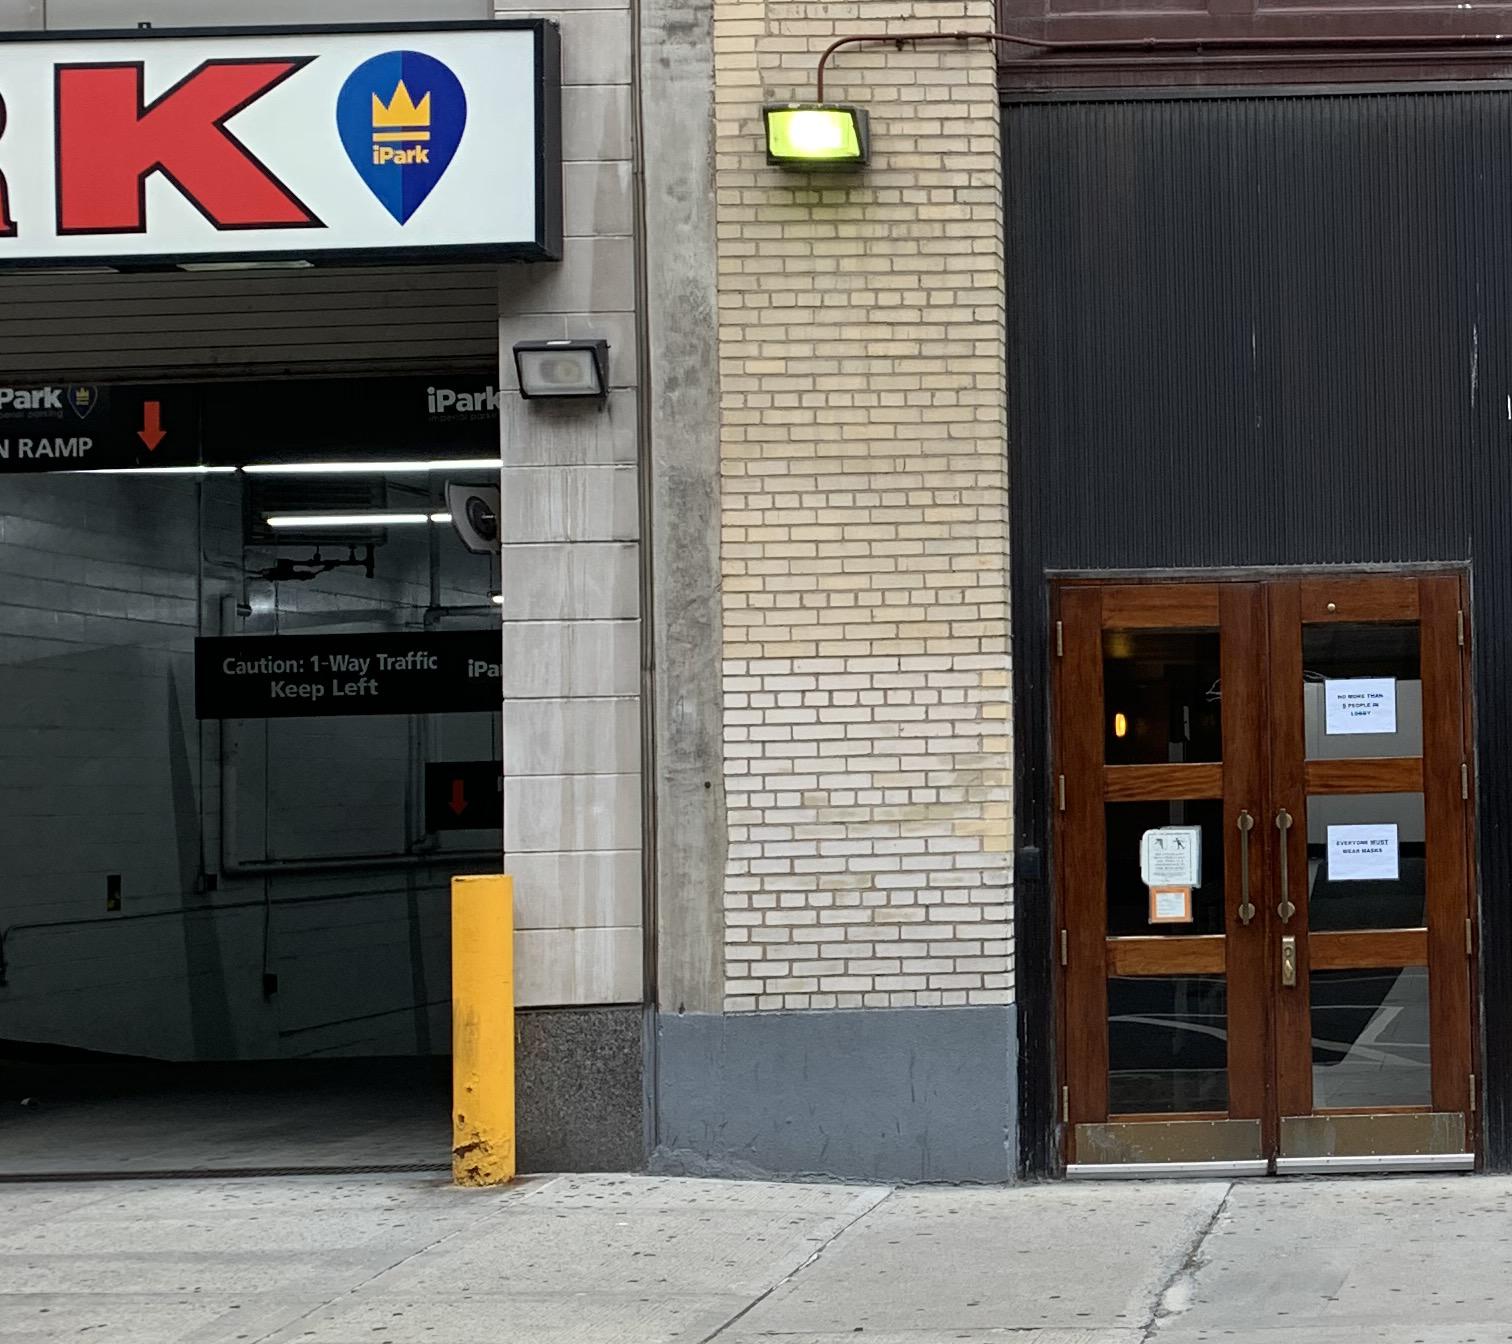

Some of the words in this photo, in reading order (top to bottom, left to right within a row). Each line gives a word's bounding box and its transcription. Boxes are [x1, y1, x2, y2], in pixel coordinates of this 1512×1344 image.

[372, 144, 430, 164] iPark
[426, 386, 501, 413] iPark
[18, 437, 94, 458] RAMP
[222, 655, 304, 675] Caution:
[310, 654, 371, 676] 1-Way
[376, 650, 439, 672] Traffic
[467, 658, 503, 678] iPa
[270, 680, 326, 702] Keep
[331, 677, 380, 697] Left
